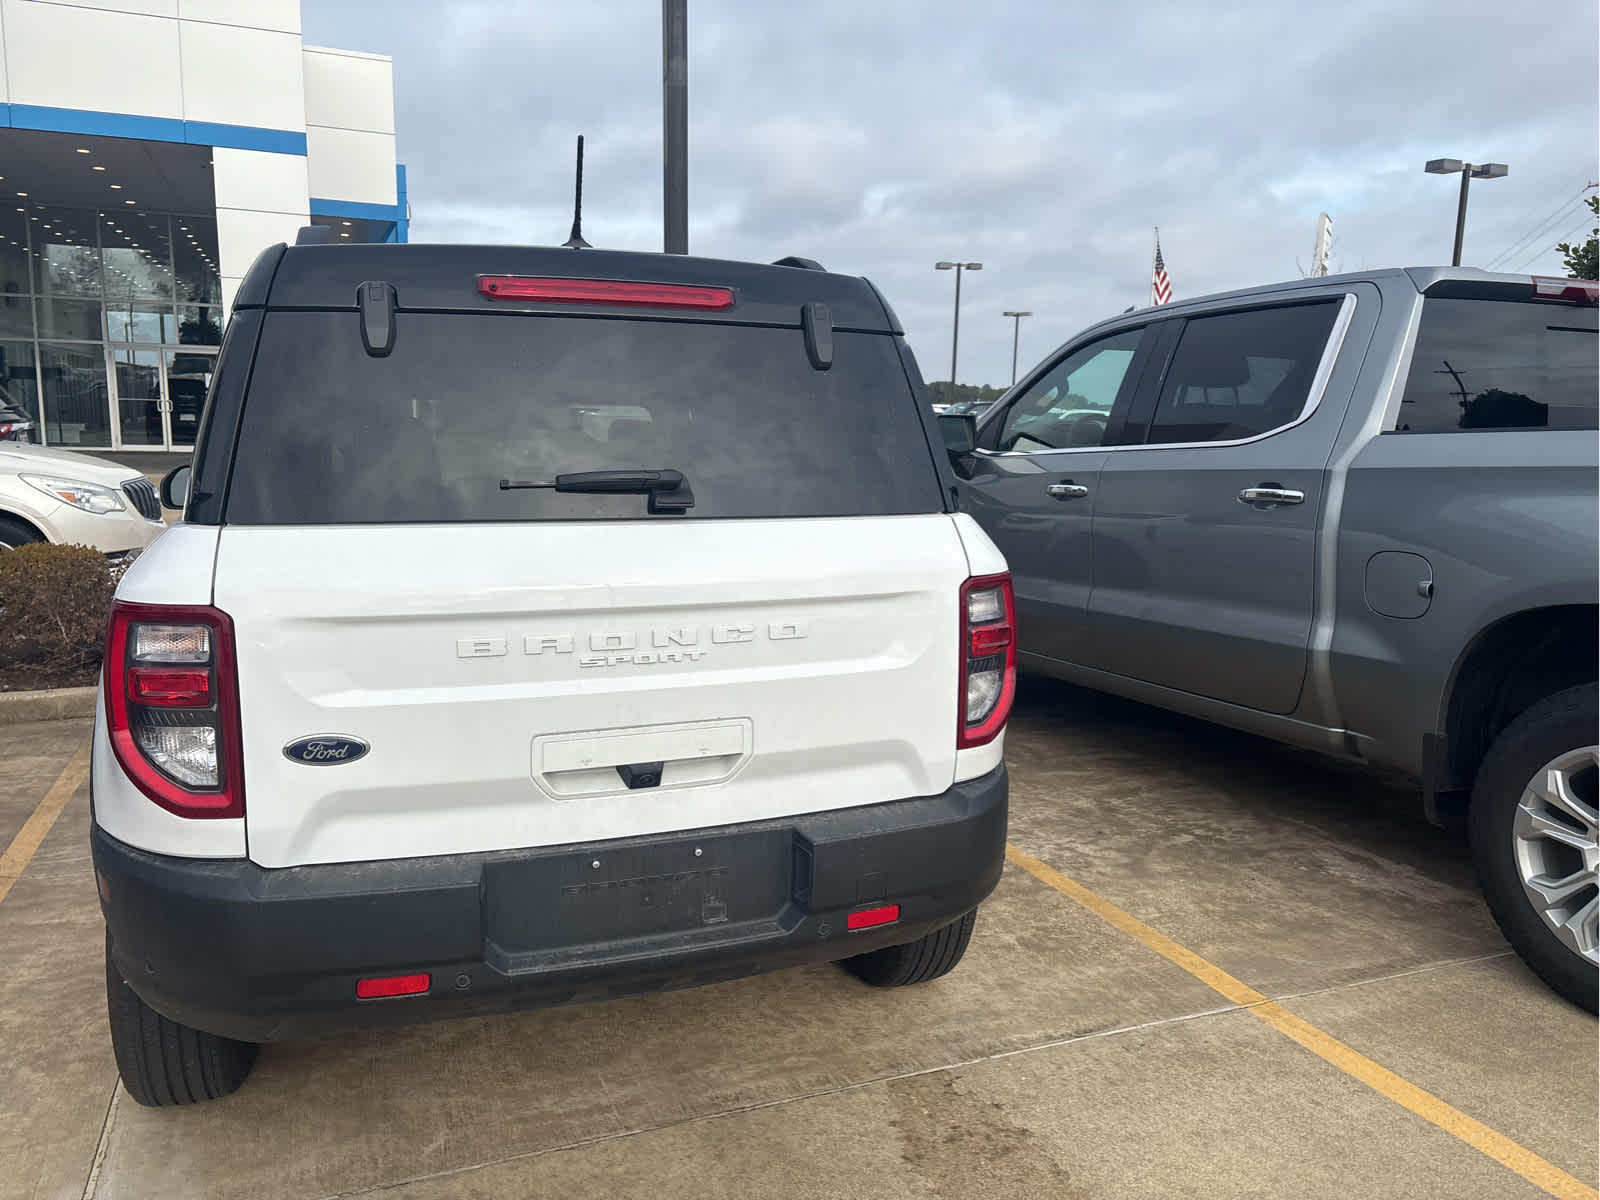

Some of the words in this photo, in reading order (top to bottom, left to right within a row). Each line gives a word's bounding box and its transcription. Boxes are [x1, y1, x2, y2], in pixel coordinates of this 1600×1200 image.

[456, 622, 809, 659] BRONCO
[579, 648, 706, 668] SPORT
[303, 741, 350, 760] Ford
